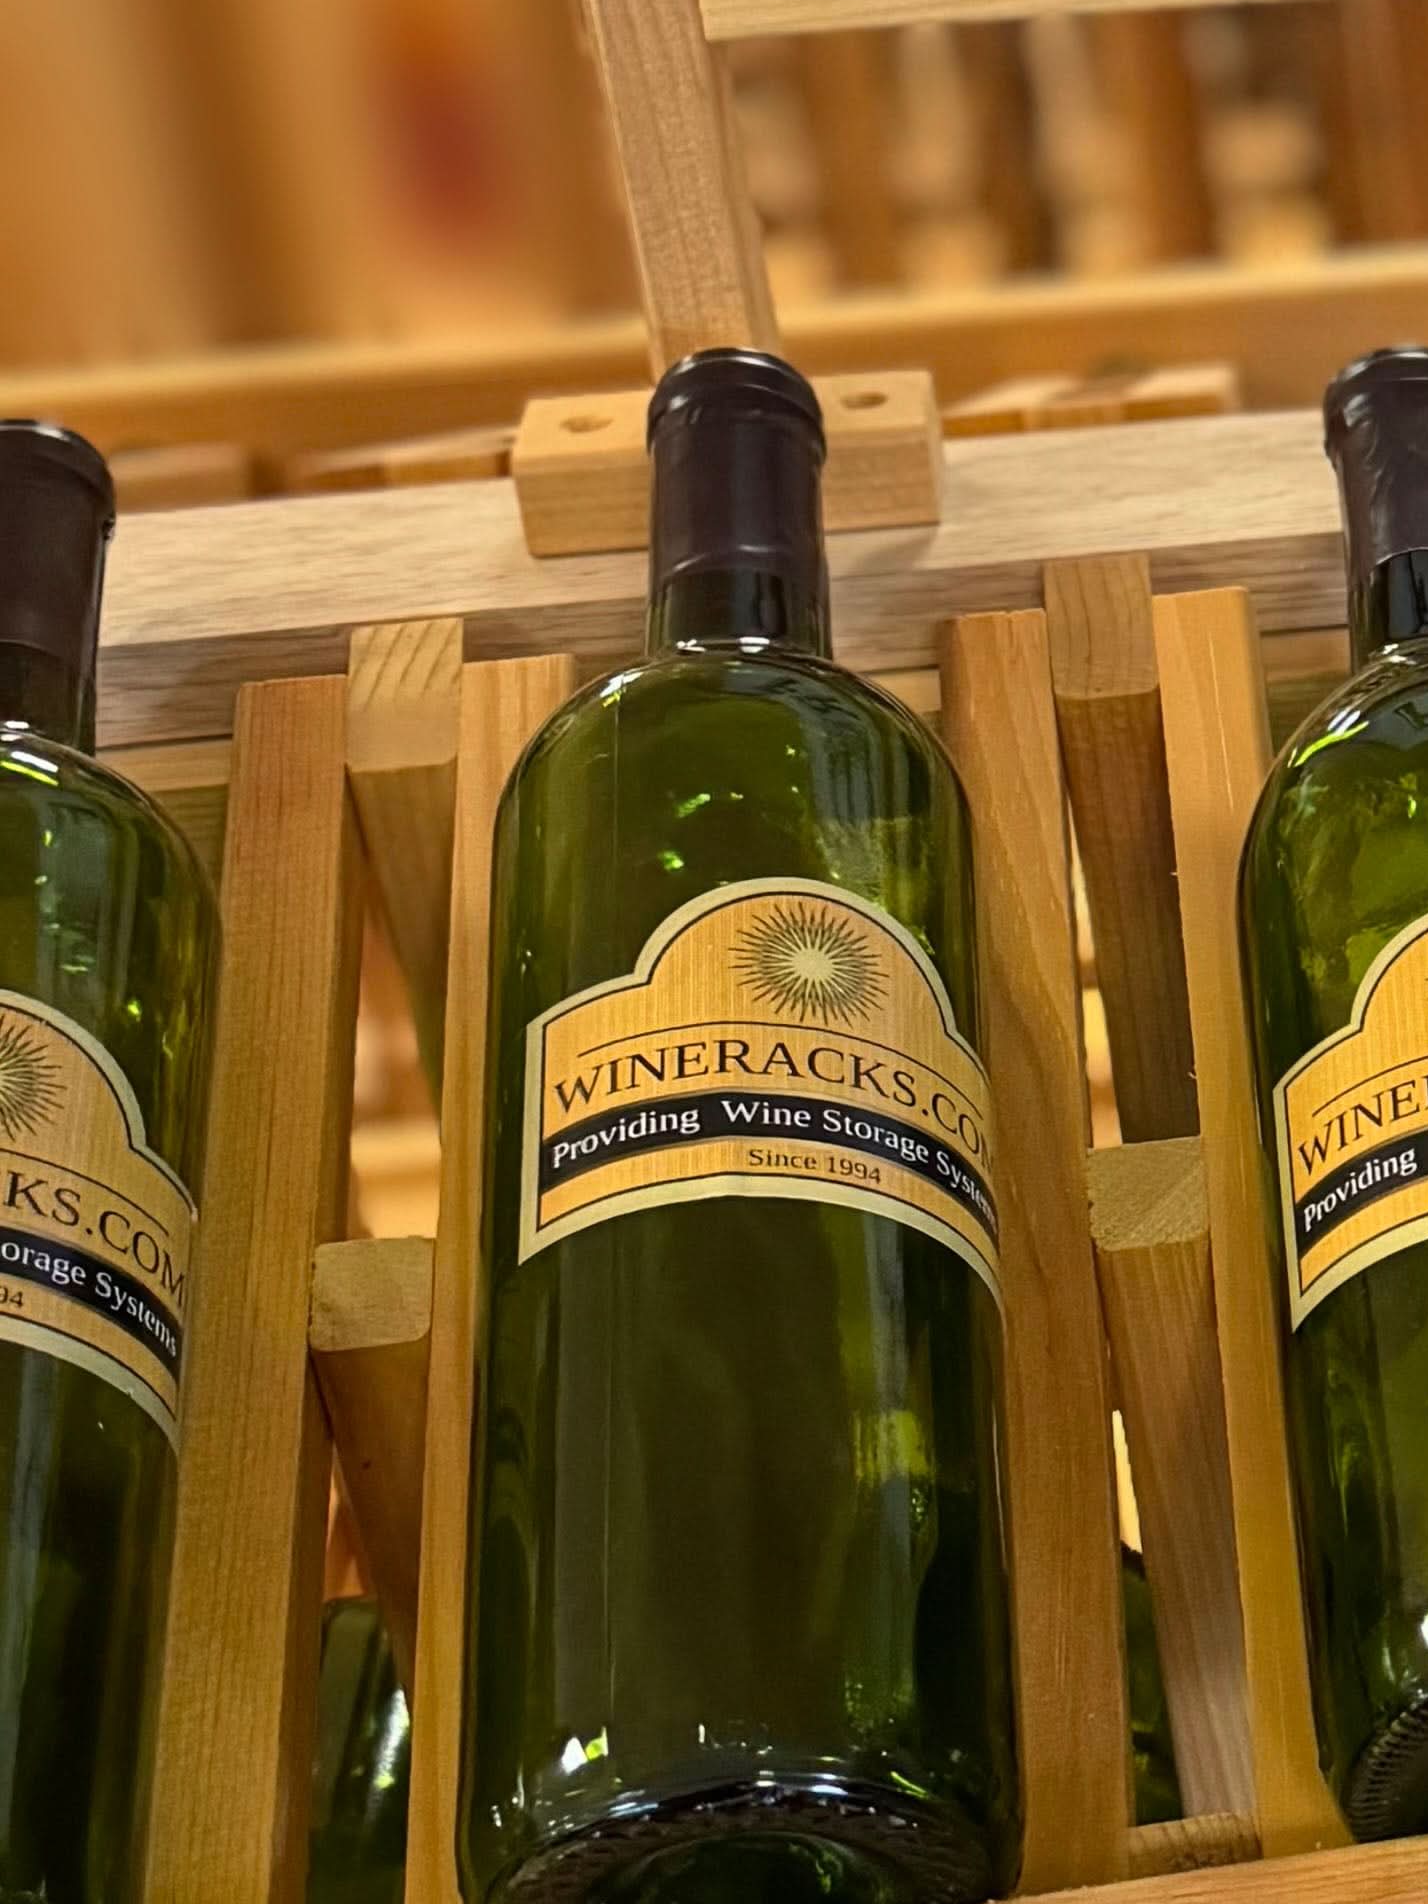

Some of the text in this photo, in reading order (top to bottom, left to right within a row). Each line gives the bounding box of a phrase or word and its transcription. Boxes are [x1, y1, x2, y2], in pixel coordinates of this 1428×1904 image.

[552, 1106, 700, 1169] Providing
[720, 1098, 812, 1128] Wine
[822, 1109, 929, 1164] Storage
[747, 1148, 882, 1185] Since 1994
[1303, 1146, 1418, 1232] Providing
[0, 1170, 185, 1309] KS.COM
[0, 1242, 177, 1357] orage Systems
